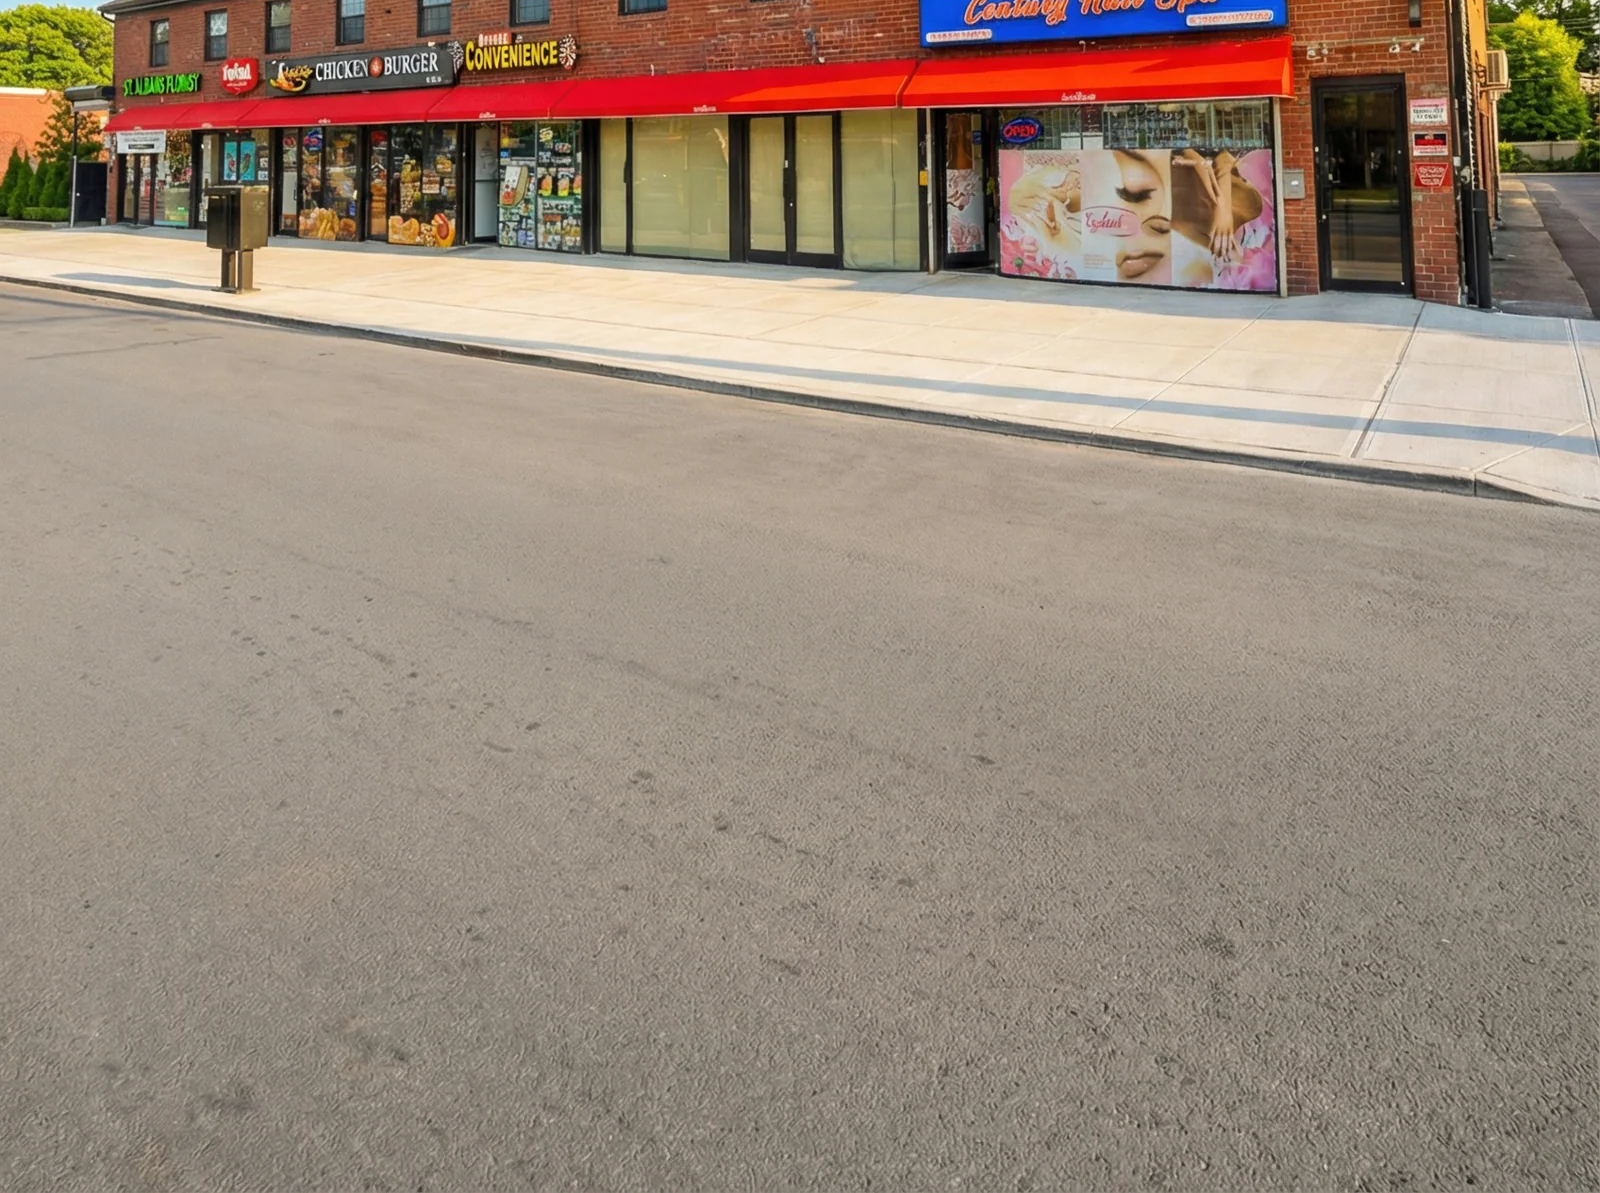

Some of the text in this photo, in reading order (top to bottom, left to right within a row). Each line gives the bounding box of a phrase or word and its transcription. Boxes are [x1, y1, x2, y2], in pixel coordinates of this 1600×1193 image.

[315, 58, 369, 82] CHICKEN
[384, 52, 439, 76] BURGER
[465, 40, 558, 71] CONVENIENCE
